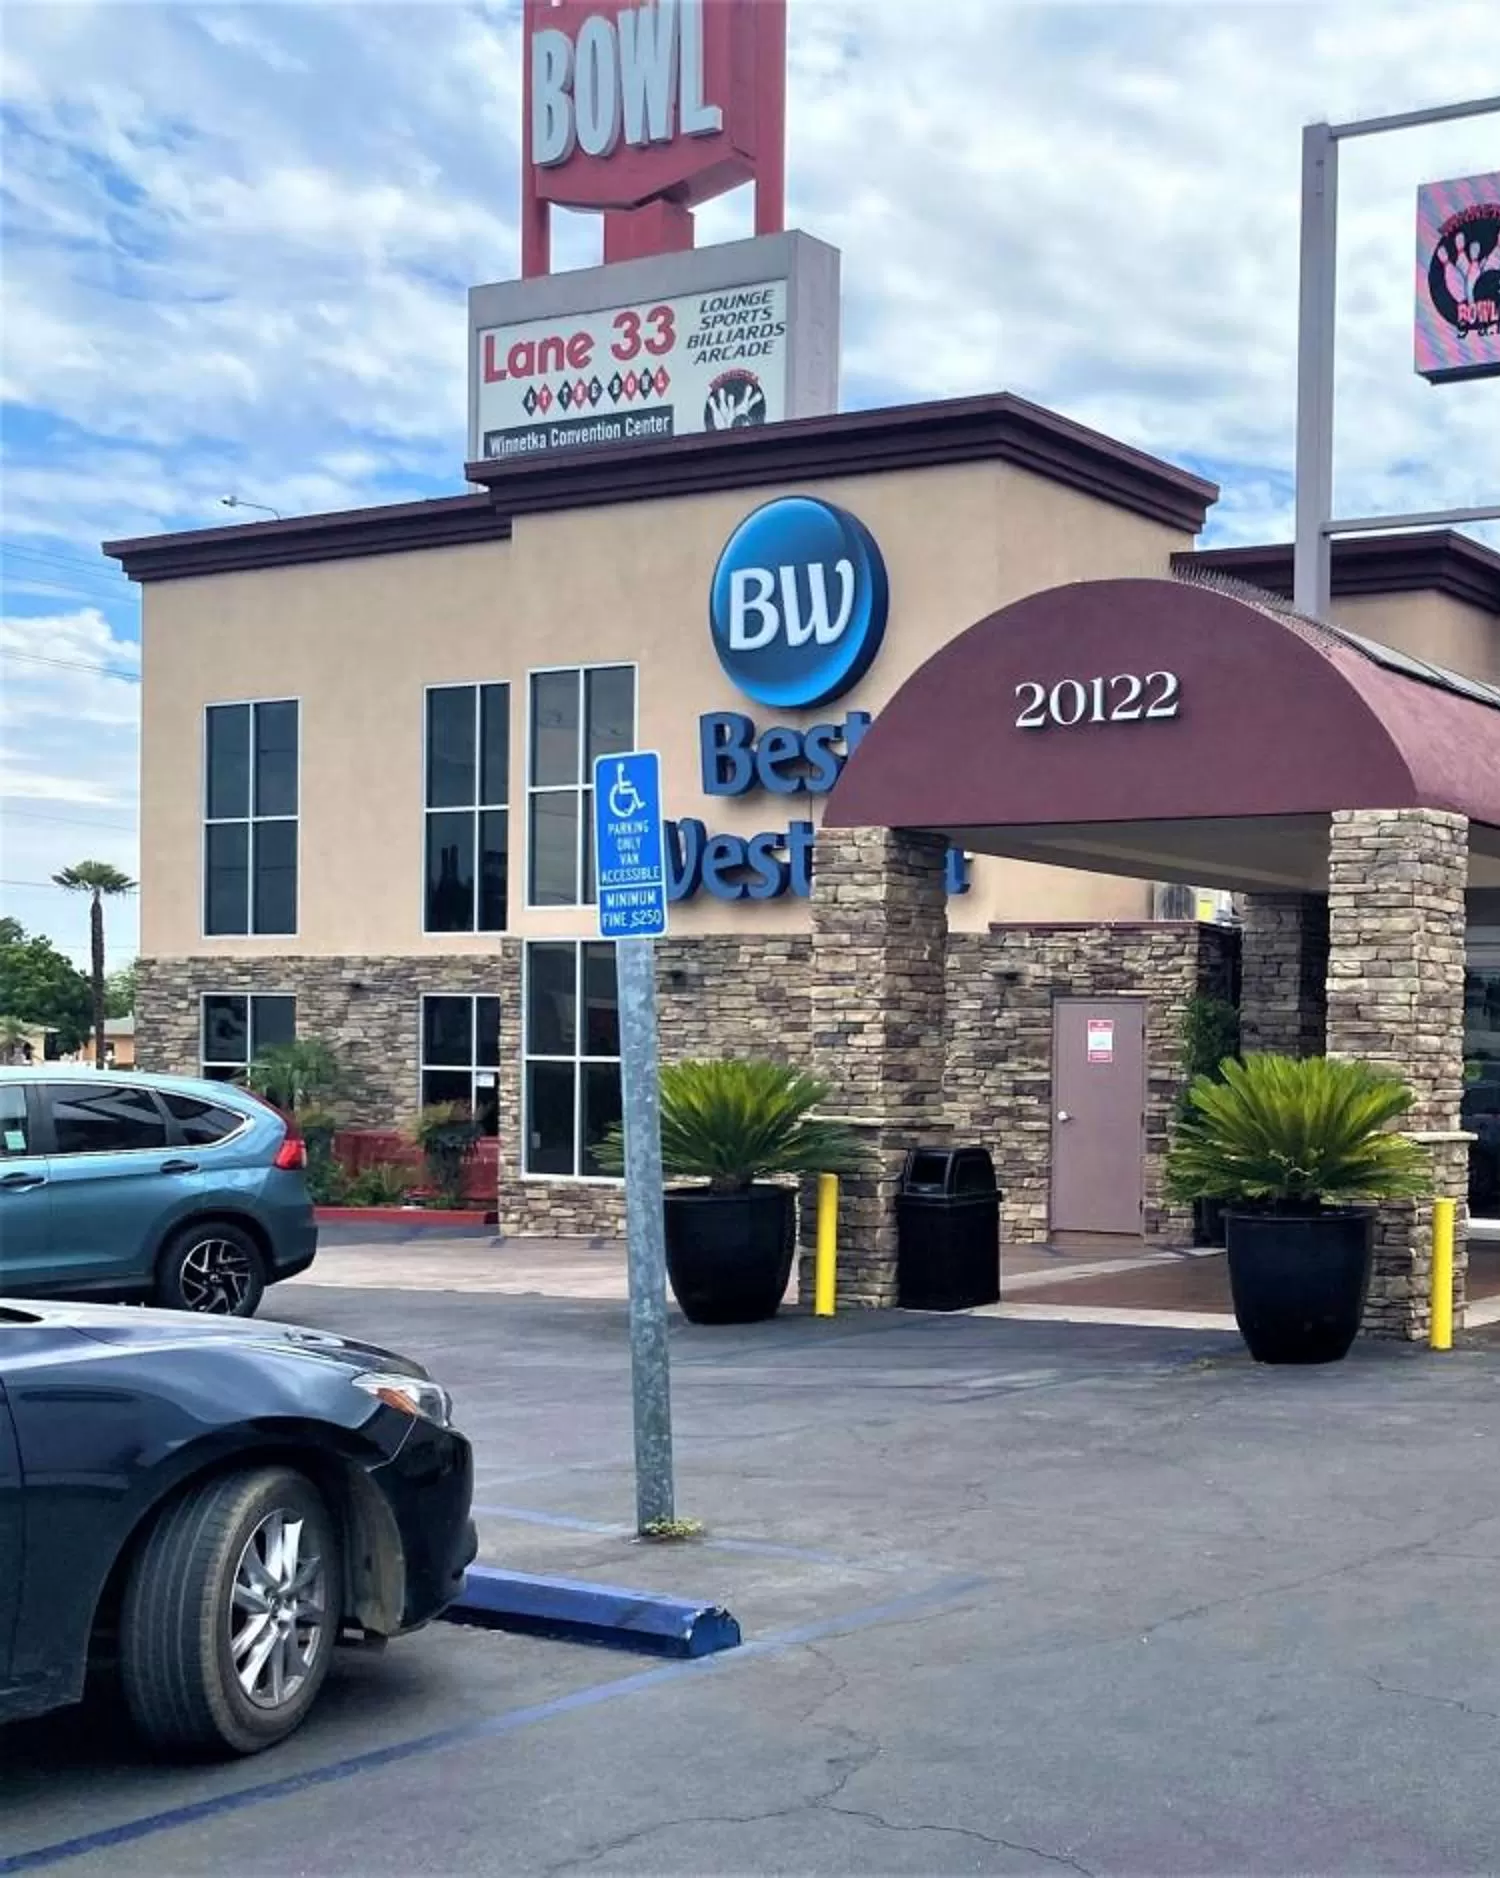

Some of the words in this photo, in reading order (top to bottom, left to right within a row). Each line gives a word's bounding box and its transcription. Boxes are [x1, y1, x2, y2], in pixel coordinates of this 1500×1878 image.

[532, 0, 723, 166] BOWL
[700, 289, 775, 314] LOUNGE
[700, 305, 773, 331] SPORTS
[484, 331, 595, 384] Lane
[610, 305, 677, 361] 33
[687, 321, 786, 349] BILLIARDS
[693, 340, 776, 365] ARCADE
[490, 433, 547, 454] Winnetka
[550, 423, 622, 446] Convention
[625, 414, 670, 437] Center
[729, 559, 856, 652] BW
[1015, 670, 1180, 728] 20122
[607, 819, 650, 836] PARKING
[617, 836, 642, 851] ONLY
[619, 852, 640, 867] VAN
[601, 865, 661, 884] ACCESSIBLE
[606, 889, 657, 909] MINIMUM
[602, 911, 628, 929] FINE
[629, 908, 663, 929] $250
